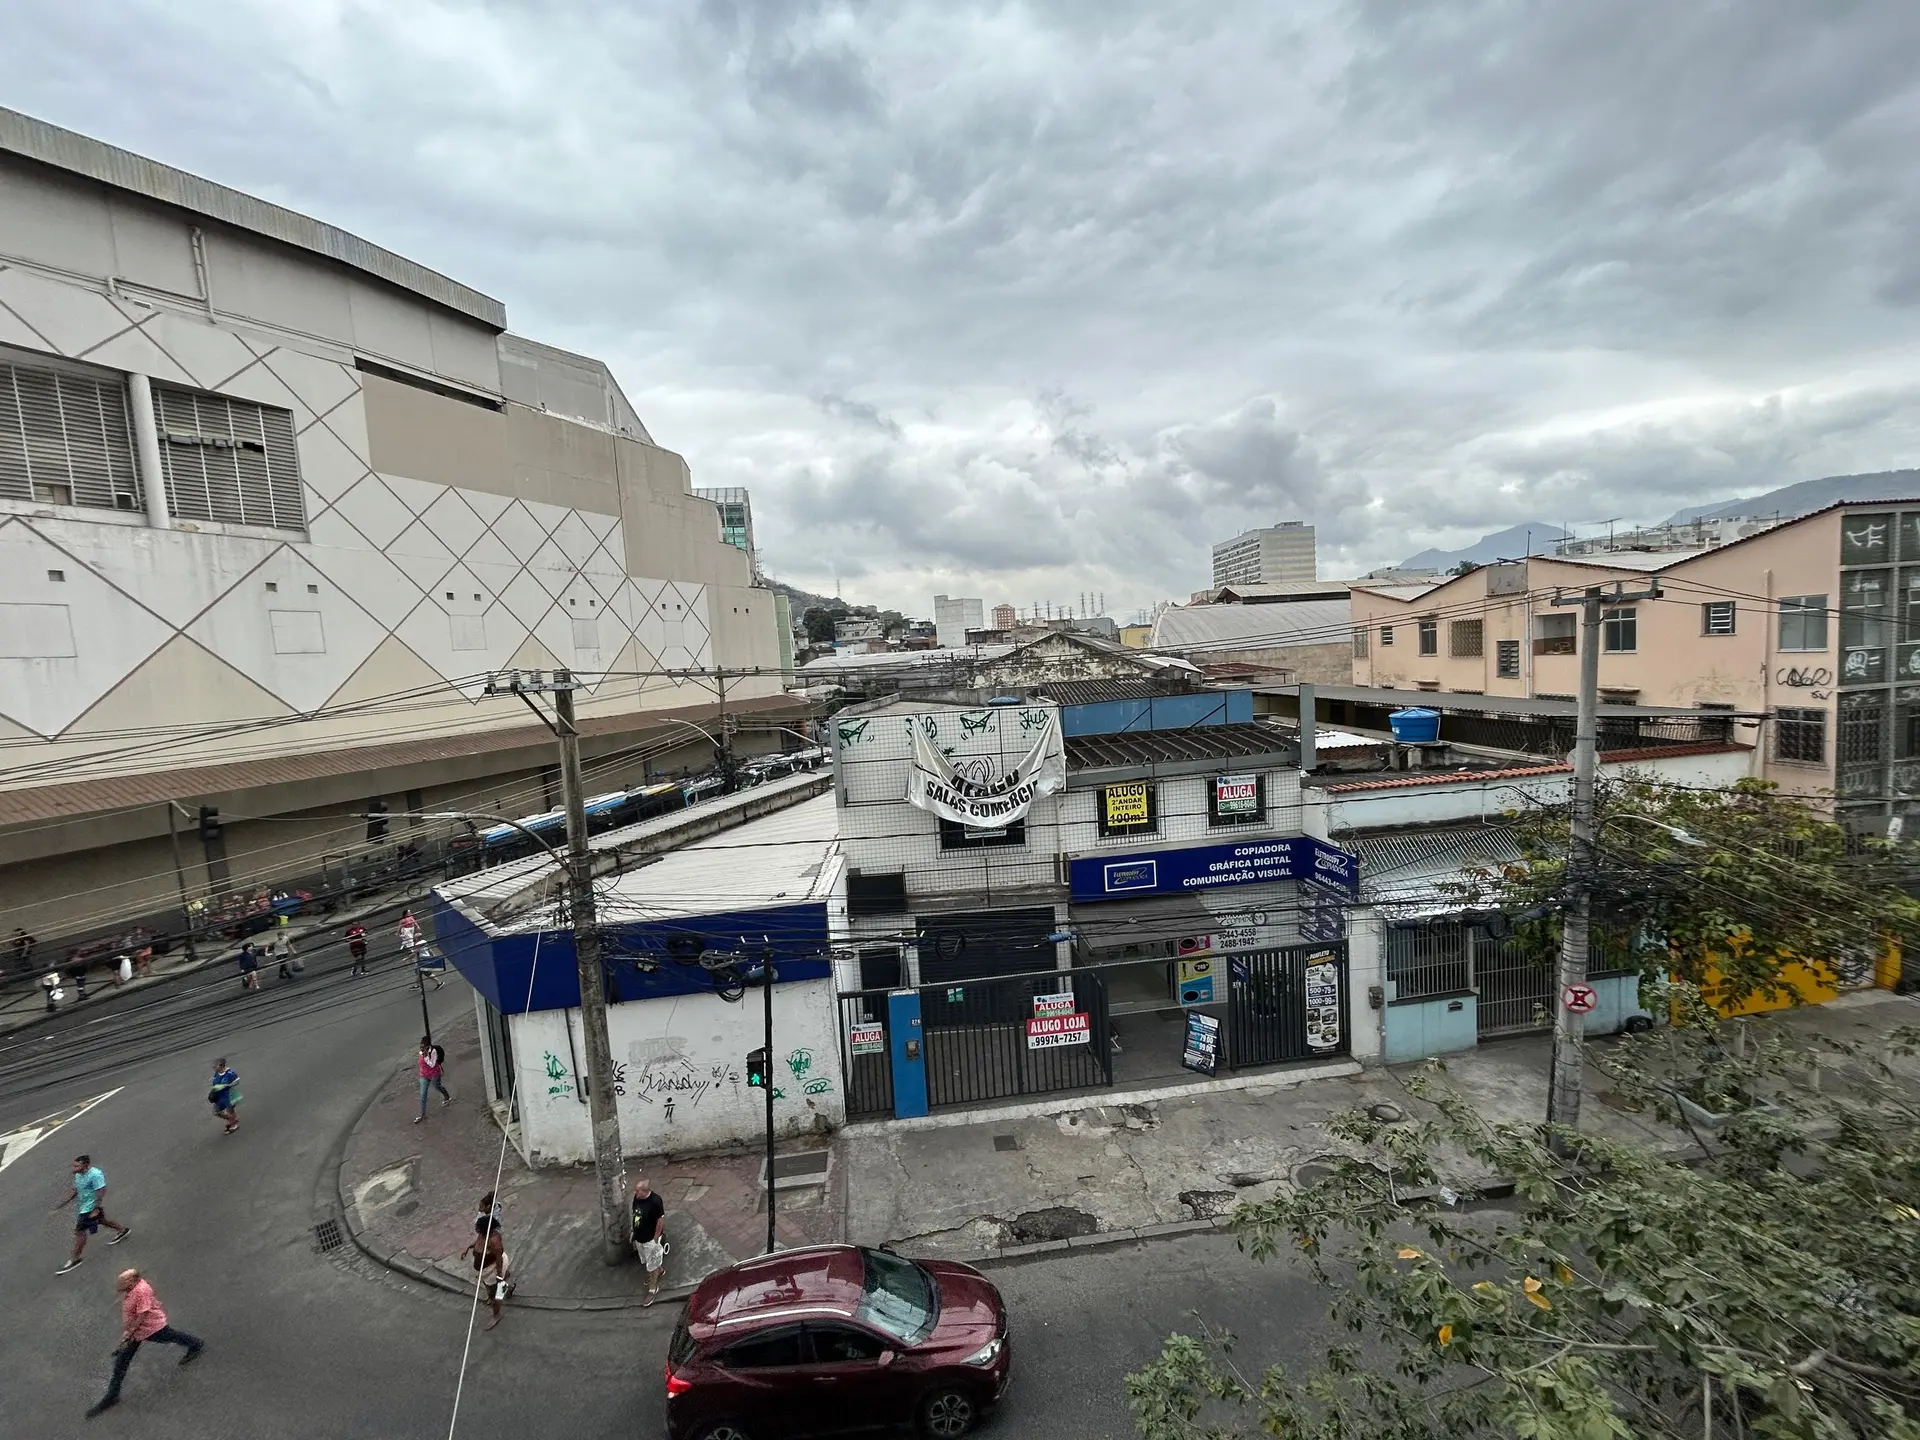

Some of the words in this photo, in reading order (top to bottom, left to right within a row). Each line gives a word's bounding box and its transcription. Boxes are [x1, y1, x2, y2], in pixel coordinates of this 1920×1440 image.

[926, 780, 967, 813] SALAS
[1109, 784, 1144, 798] ALUGO
[1222, 785, 1253, 799] ALUGA
[1112, 803, 1142, 812] INTEIRO
[1118, 797, 1143, 805] ANDAR
[1234, 843, 1292, 856] COPIADORA
[1209, 859, 1252, 872] GRÁFICA
[1253, 855, 1292, 867] DIGITAL
[1182, 869, 1256, 887] COMUNICAÇÃO
[1257, 867, 1293, 879] VISUAL
[1220, 936, 1255, 949] 2488-1942
[1038, 1001, 1072, 1011] ALUGA
[1030, 1019, 1061, 1034] ALUGO
[1063, 1016, 1086, 1030] LOJA
[854, 1031, 881, 1043] ALUGA
[1035, 1032, 1082, 1047] 99974-7257
